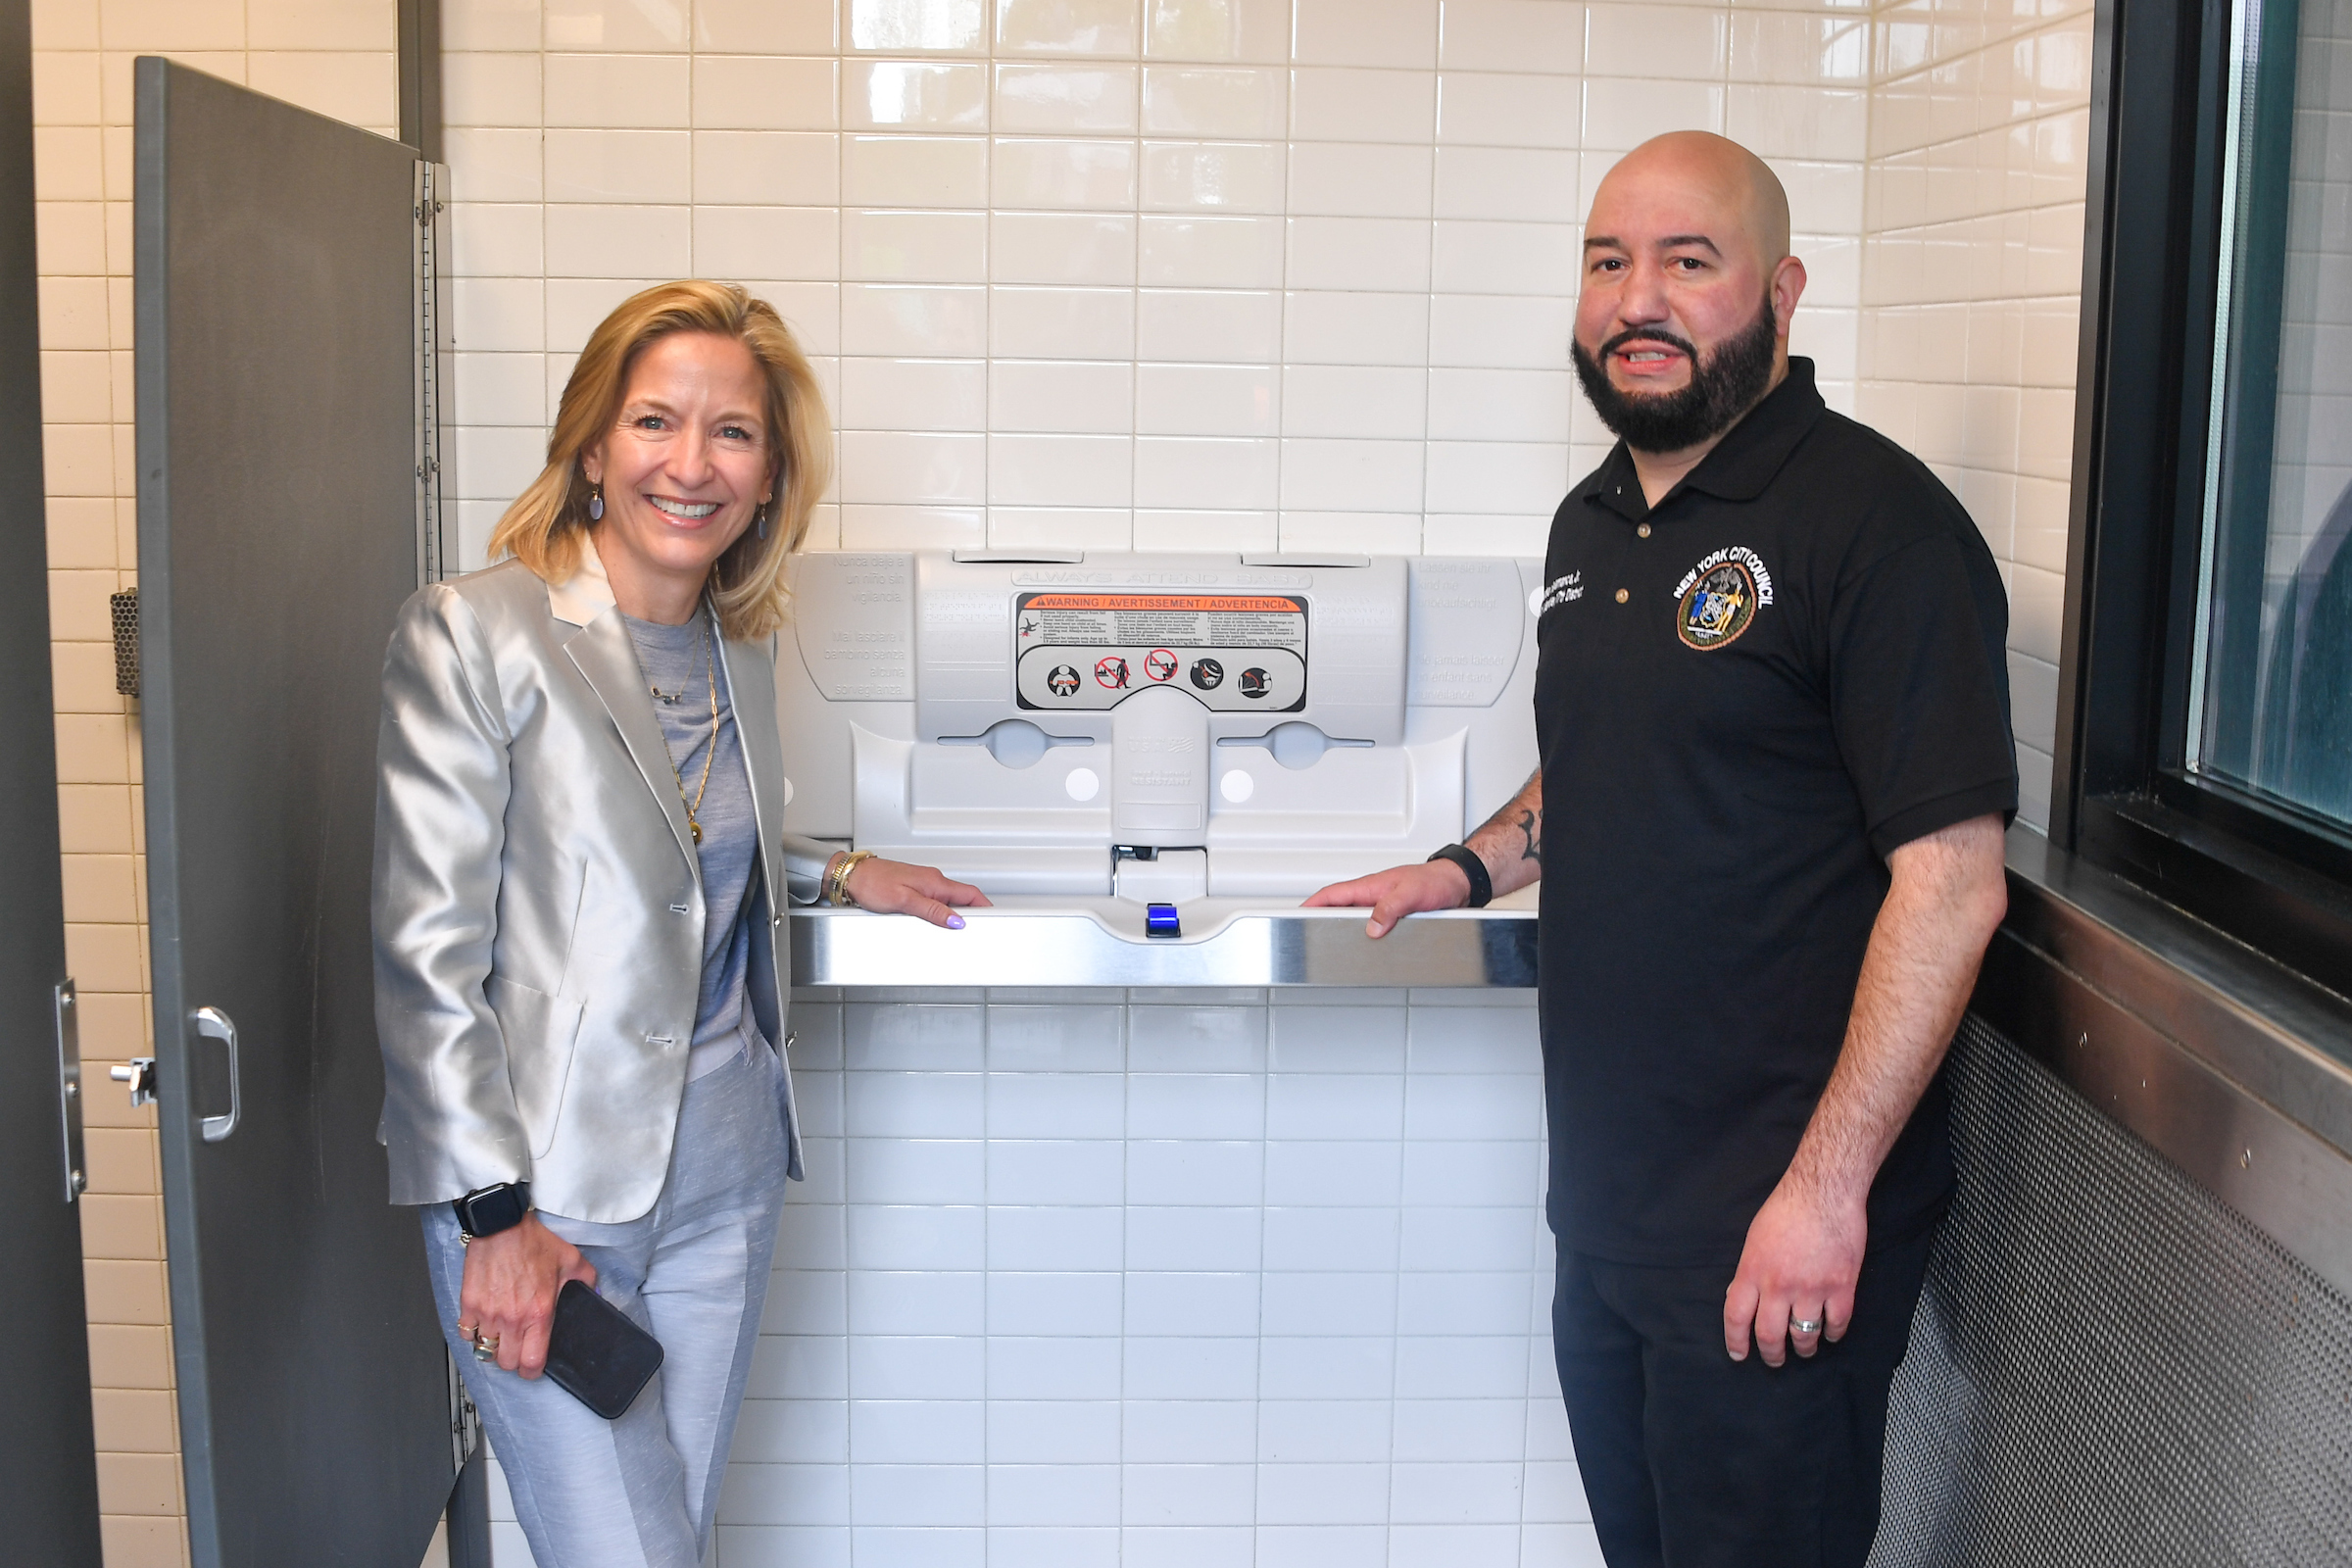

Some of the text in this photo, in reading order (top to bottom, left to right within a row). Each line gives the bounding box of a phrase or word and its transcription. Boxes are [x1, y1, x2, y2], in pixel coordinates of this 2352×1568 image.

[1016, 571, 1306, 585] ALWAYS ATTEND BABY
[1673, 546, 1773, 610] NEW YORK CITY COUNCIL
[1046, 598, 1099, 607] WARNING
[1108, 599, 1200, 608] AVERTISSEMENT
[1210, 600, 1289, 609] ADVERTENCIA
